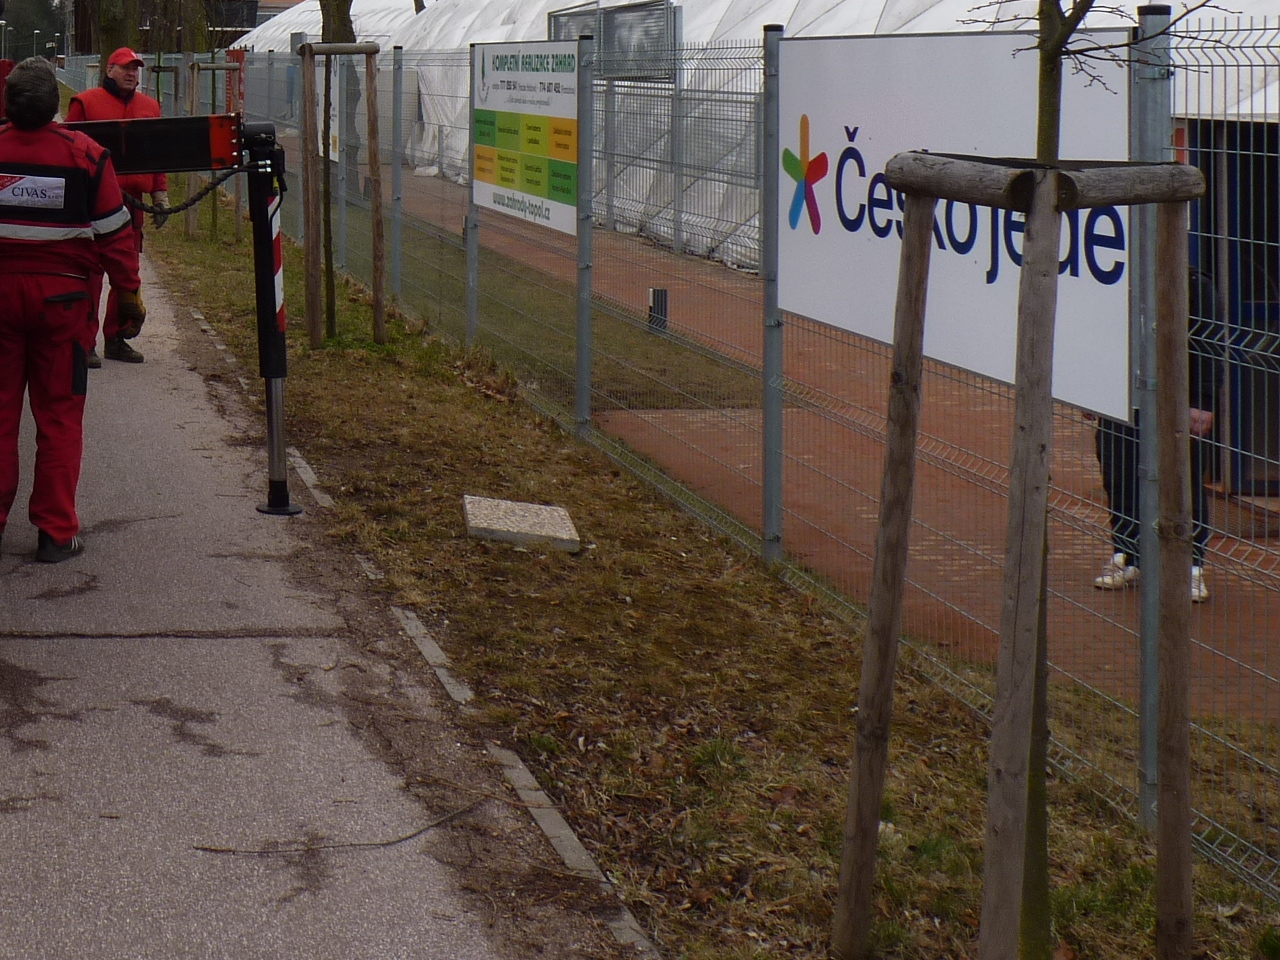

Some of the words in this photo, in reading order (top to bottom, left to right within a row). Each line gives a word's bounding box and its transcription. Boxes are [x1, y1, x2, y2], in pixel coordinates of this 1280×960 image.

[492, 50, 521, 72] KOMPLETNÍ
[521, 53, 549, 72] REALIZACE
[551, 53, 575, 73] ZAHRAD
[12, 187, 47, 199] CIVAS
[835, 126, 978, 255] Čeo
